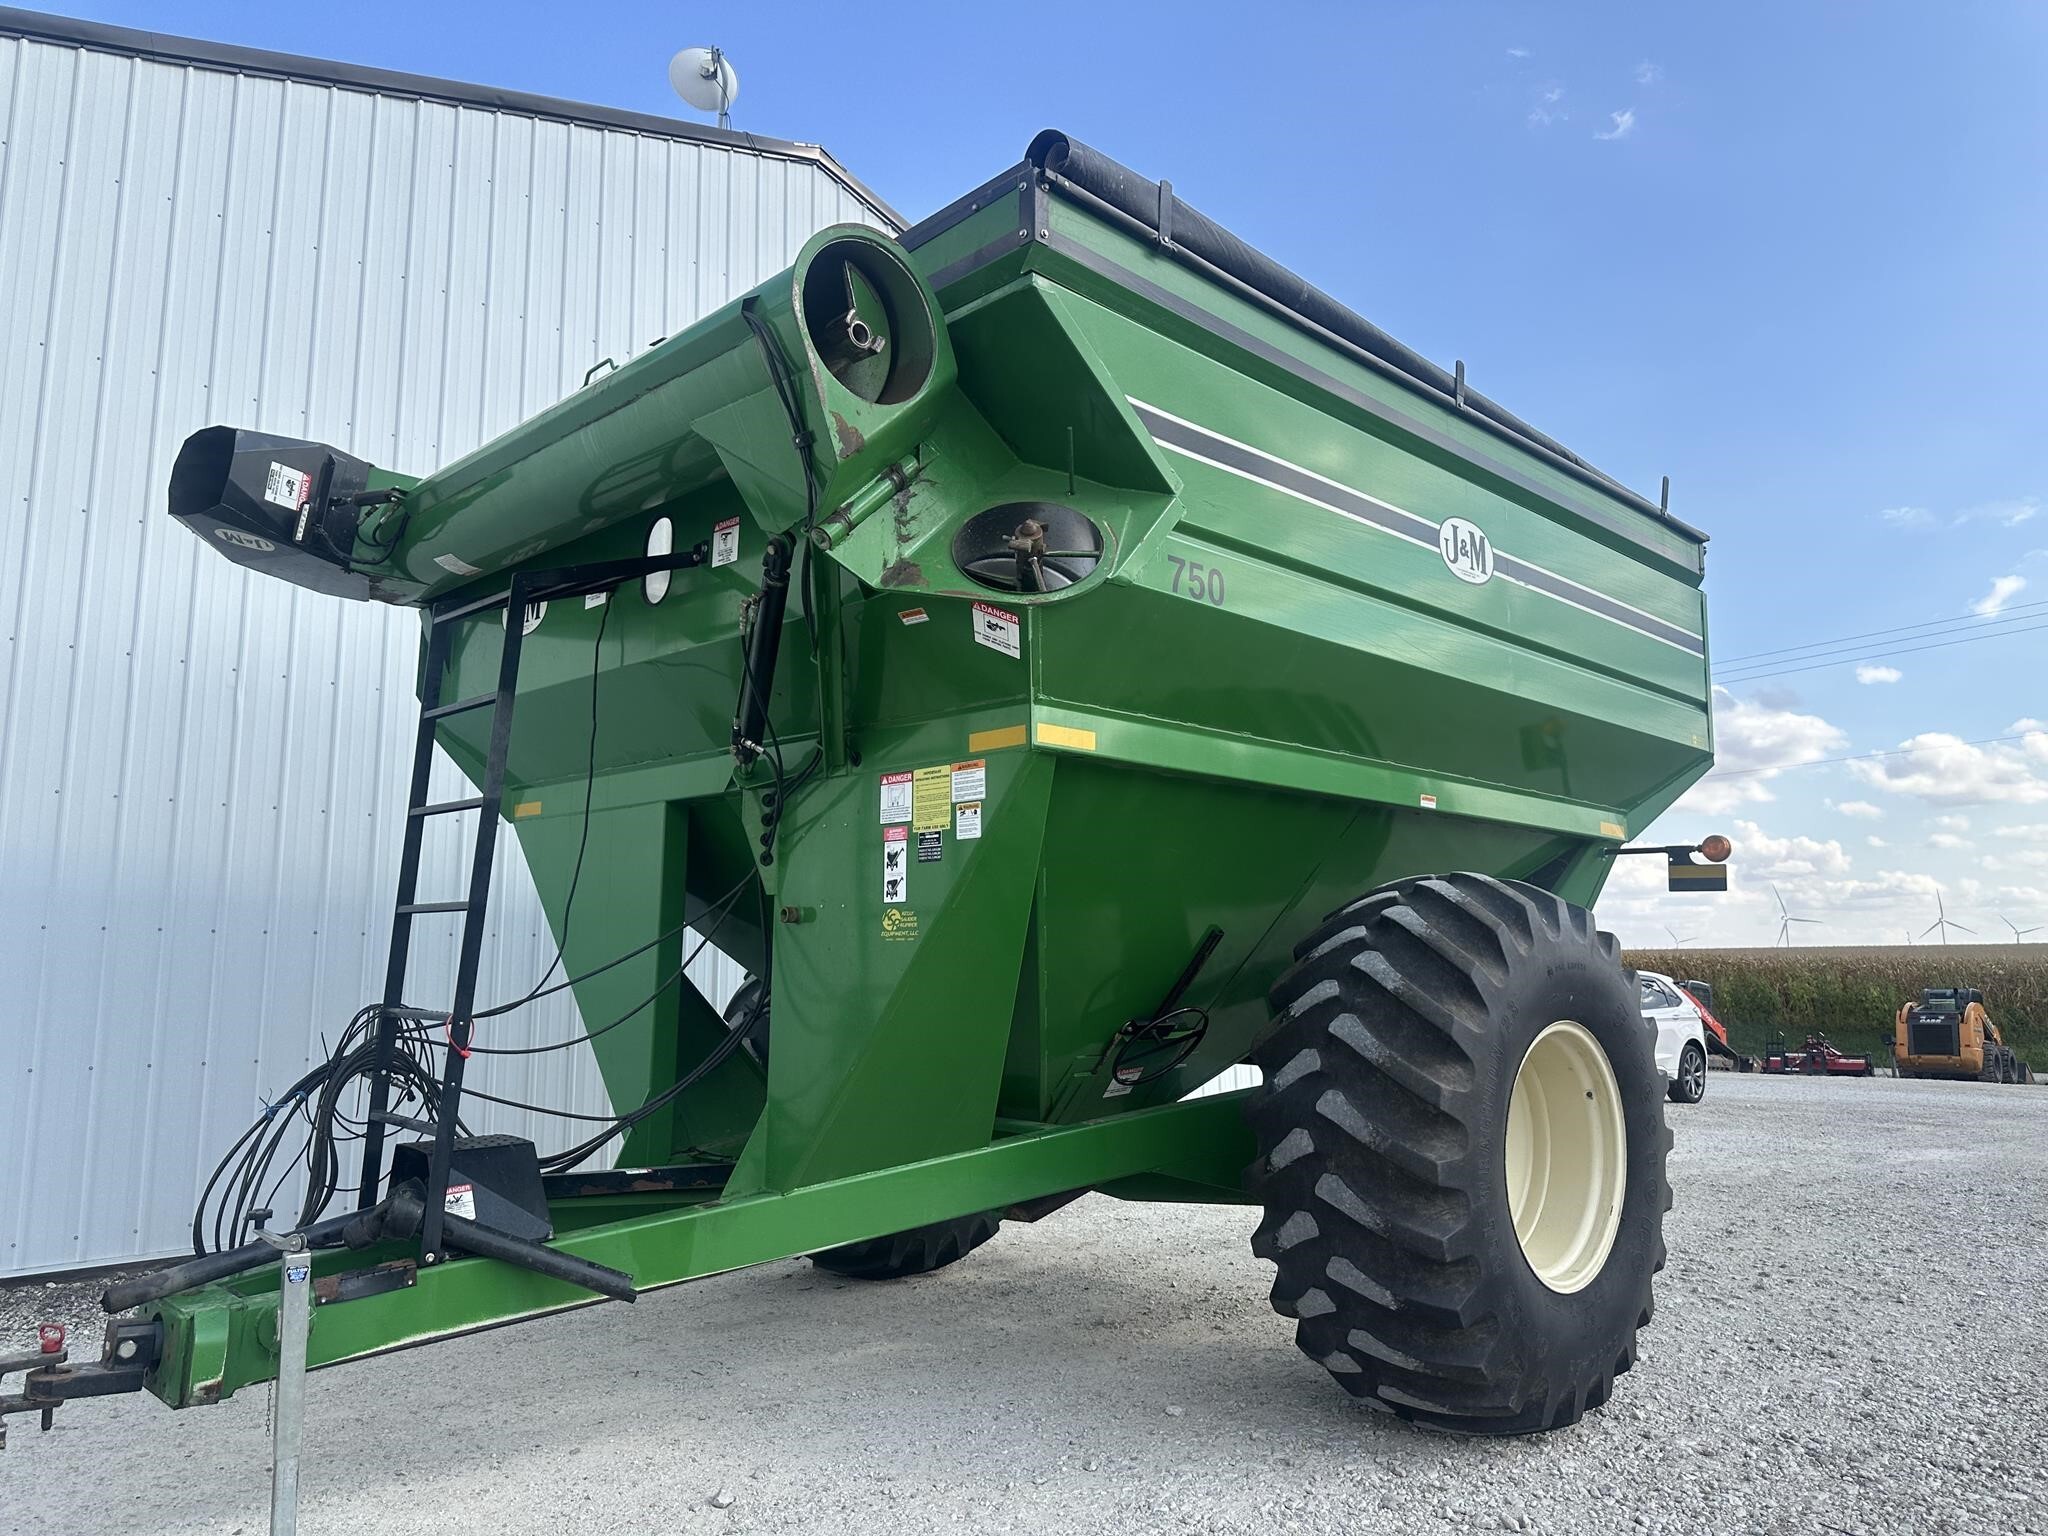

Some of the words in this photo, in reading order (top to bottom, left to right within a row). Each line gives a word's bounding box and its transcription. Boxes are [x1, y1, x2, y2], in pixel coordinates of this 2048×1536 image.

[1443, 523, 1488, 576] J&M
[1167, 554, 1225, 607] 750
[981, 604, 1019, 624] DANGER
[888, 773, 912, 784] DANGER
